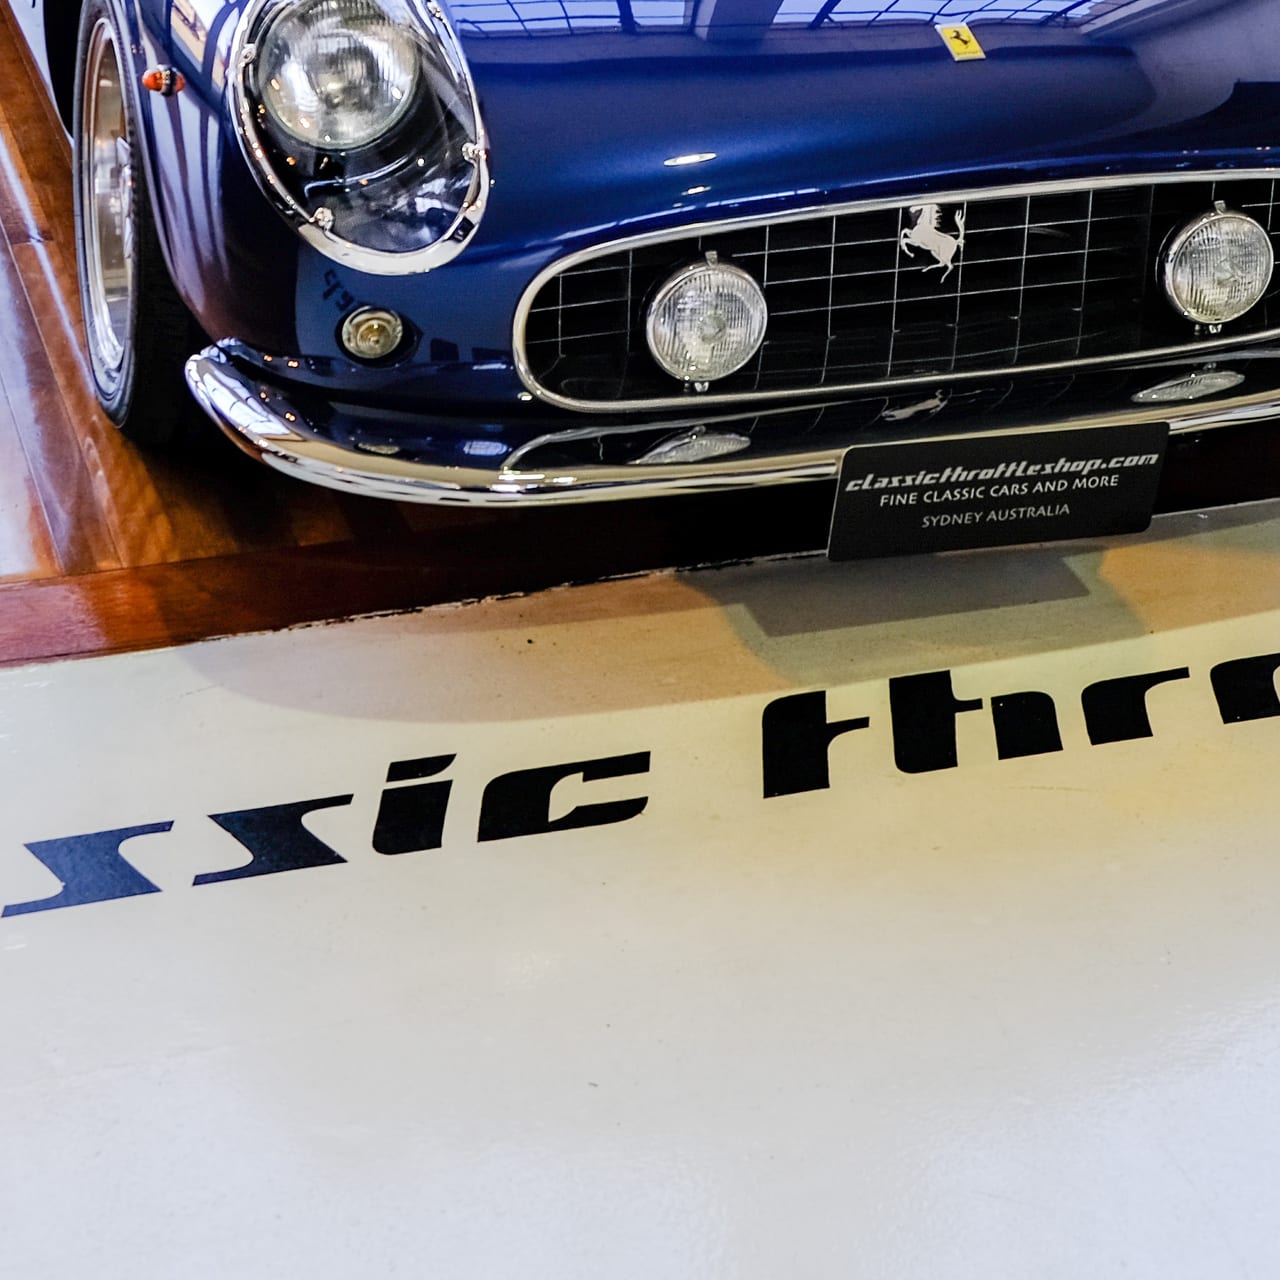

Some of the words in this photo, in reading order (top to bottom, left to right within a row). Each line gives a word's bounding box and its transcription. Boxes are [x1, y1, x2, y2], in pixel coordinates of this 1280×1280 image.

[845, 453, 1159, 492] classicthrottleshop.com
[880, 492, 918, 508] FINE
[923, 486, 985, 504] CLASSIC
[989, 482, 1029, 498] CARS
[1032, 479, 1068, 494] AND
[1071, 474, 1120, 490] MORE
[921, 511, 984, 529] SYDNEY
[986, 503, 1071, 522] AUSTRALIA
